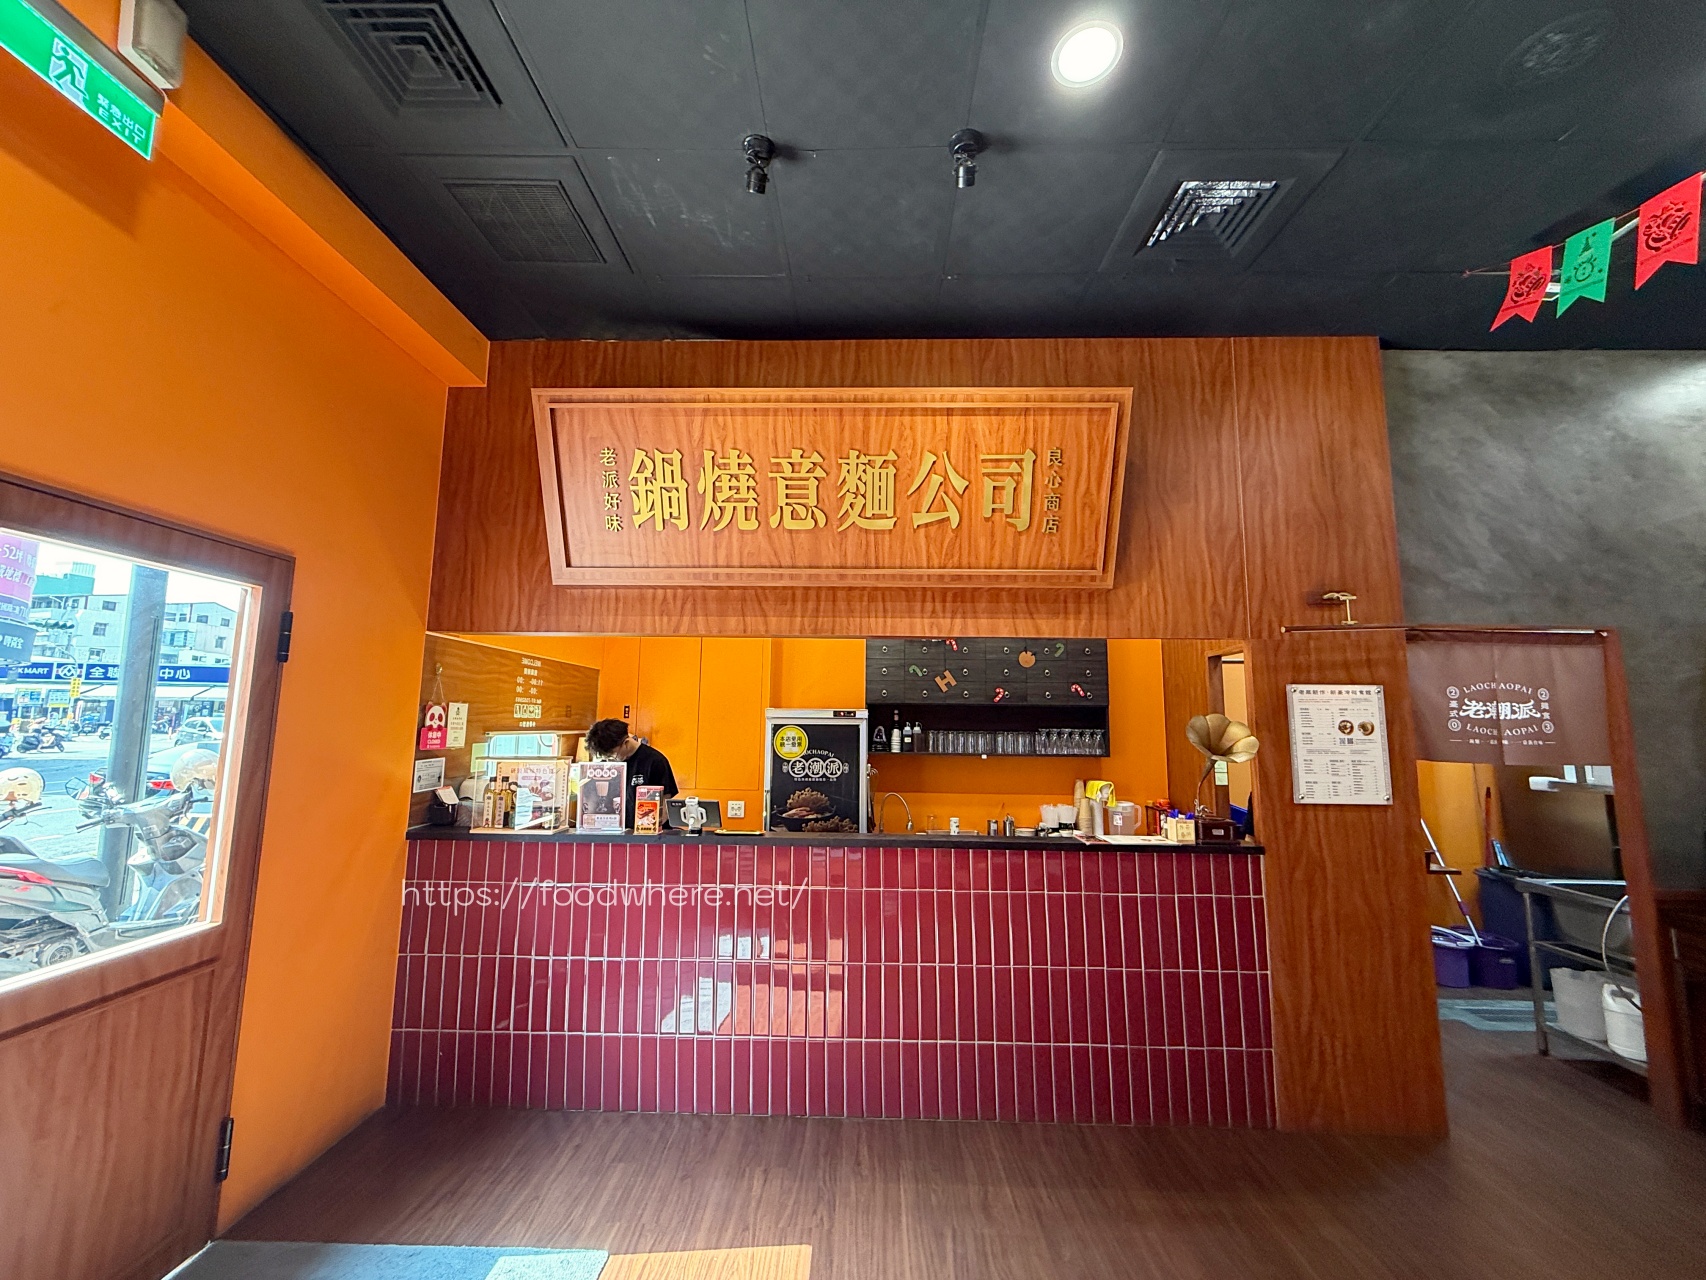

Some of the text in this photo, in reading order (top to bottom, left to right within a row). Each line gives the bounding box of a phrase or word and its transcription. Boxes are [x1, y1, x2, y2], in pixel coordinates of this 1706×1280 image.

[98, 106, 142, 144] EXIT
[599, 446, 623, 533] 老派好味
[627, 447, 1038, 534] 鍋燒意麵公司
[1042, 447, 1064, 535] 良心商店
[23, 667, 49, 675] MART
[1463, 682, 1533, 695] LAOCHAOPAI
[1459, 697, 1541, 720] 老潮派
[791, 760, 841, 775] 老潮派
